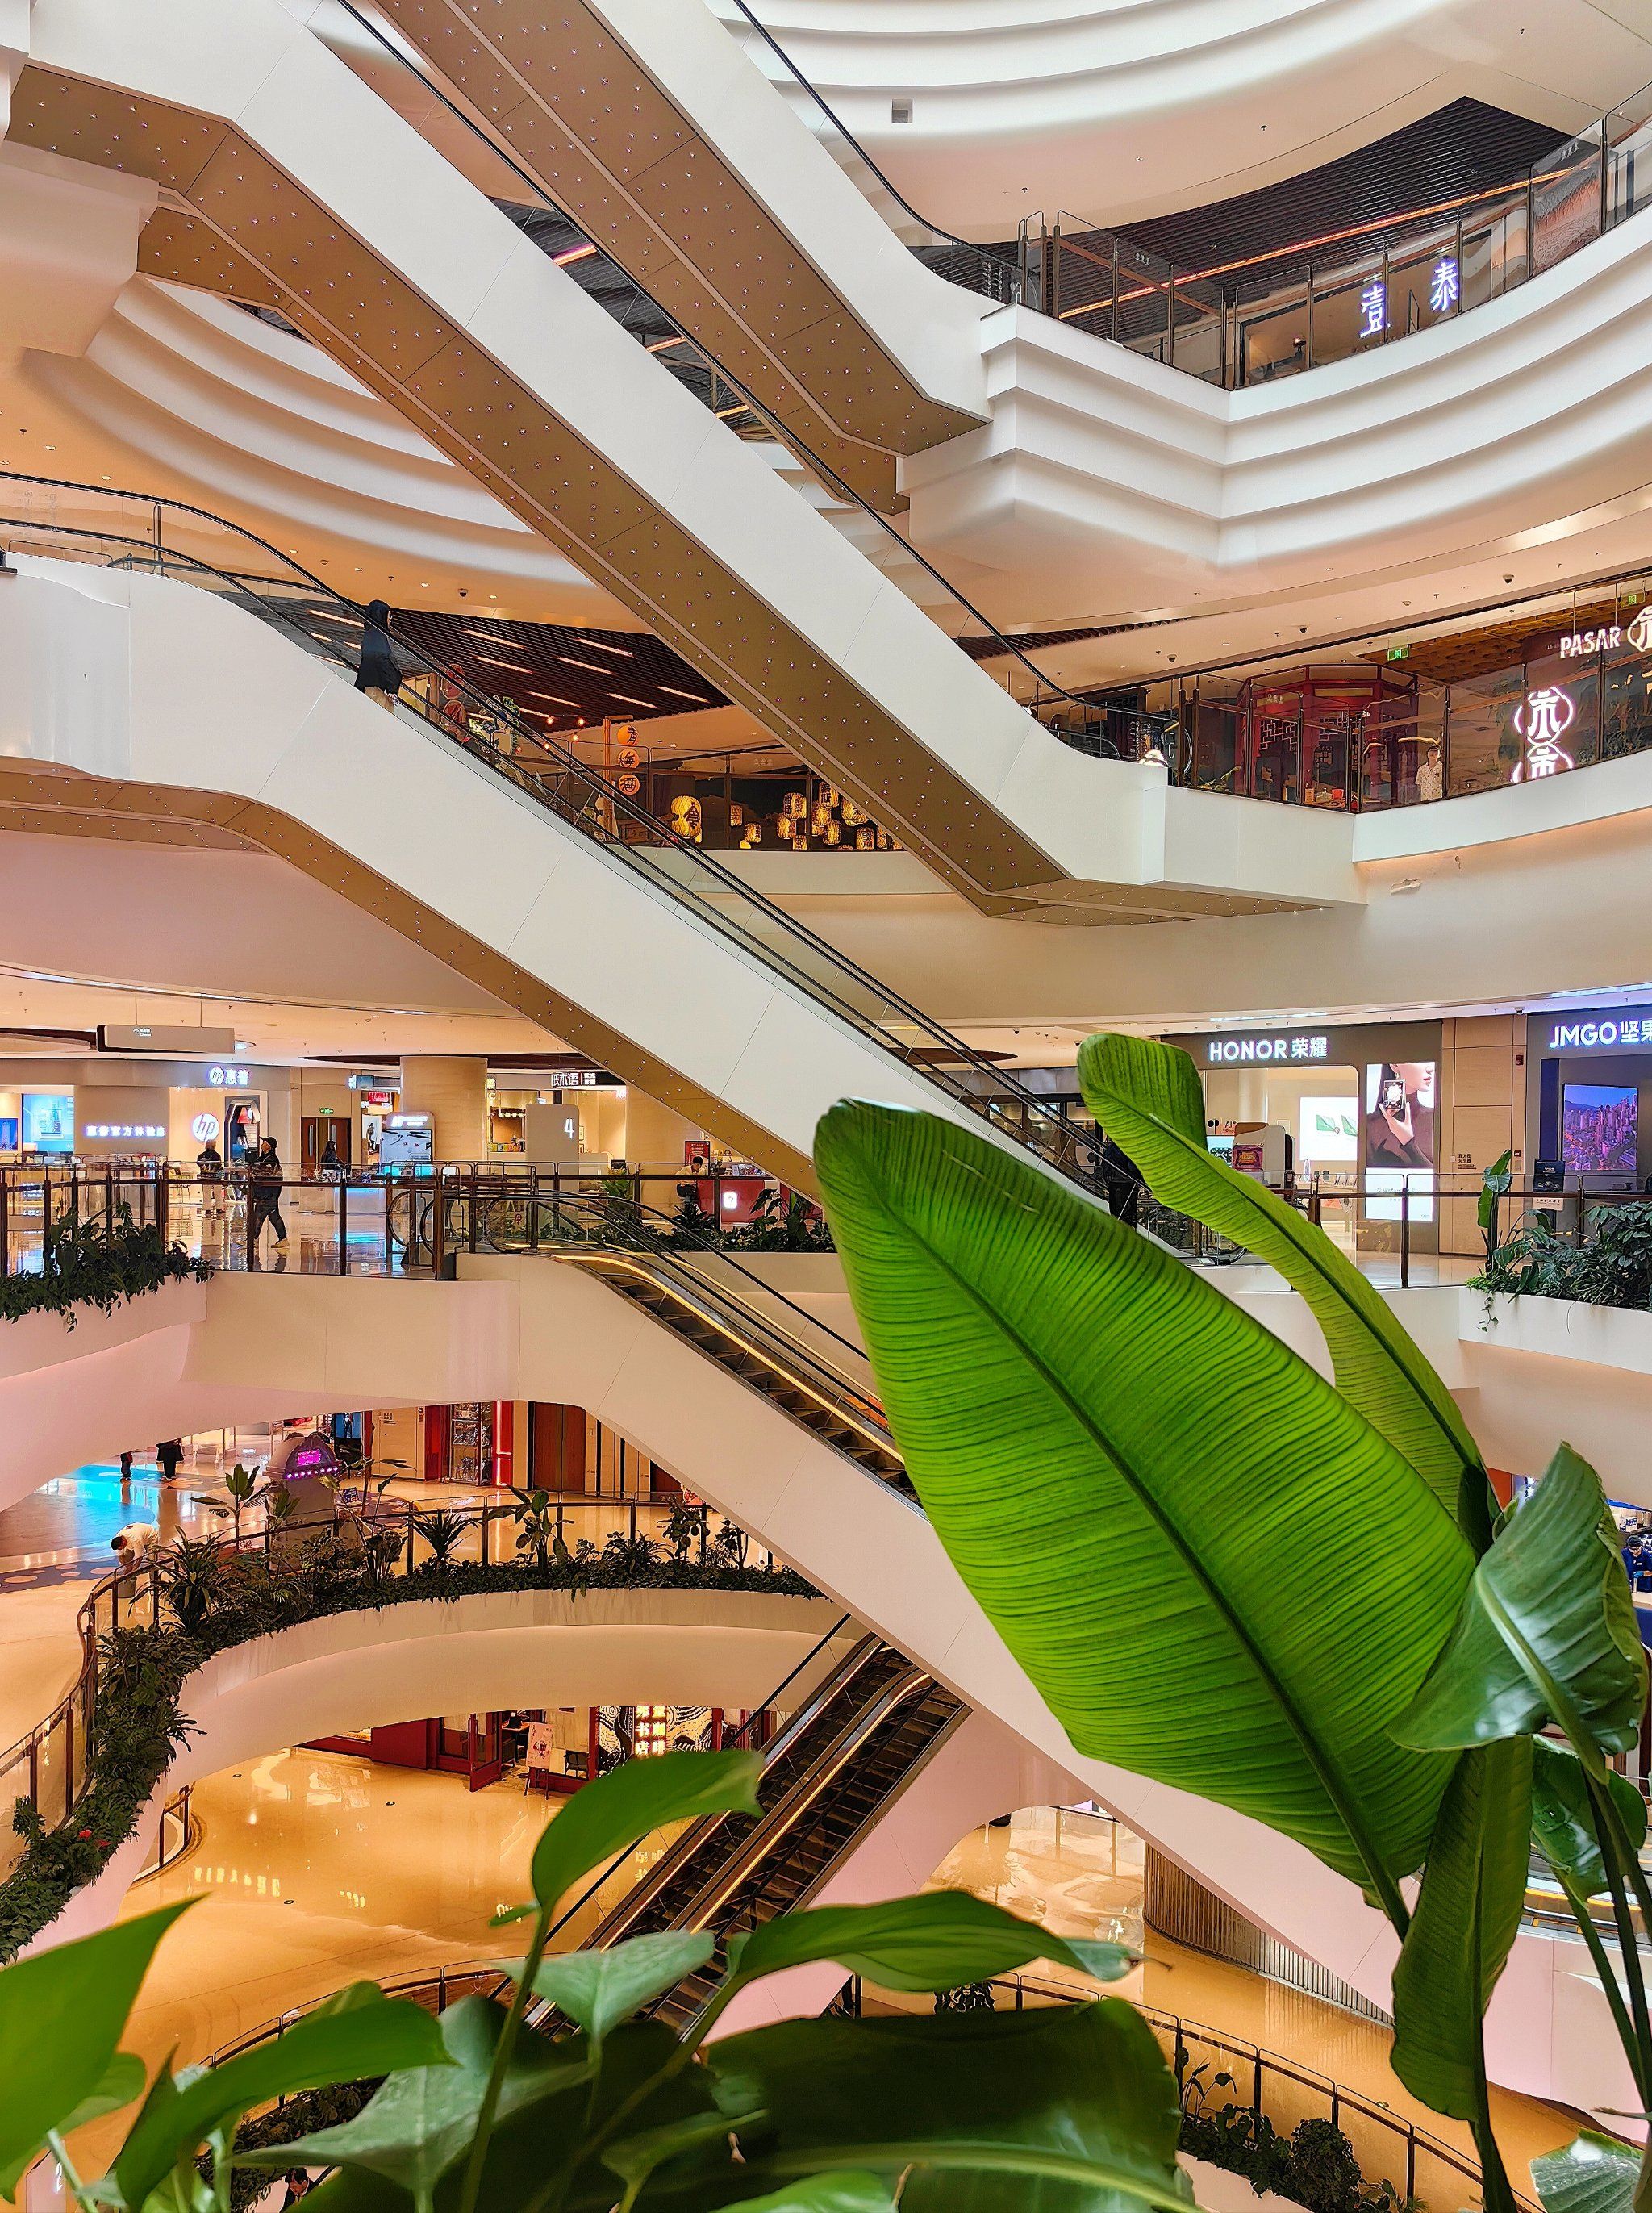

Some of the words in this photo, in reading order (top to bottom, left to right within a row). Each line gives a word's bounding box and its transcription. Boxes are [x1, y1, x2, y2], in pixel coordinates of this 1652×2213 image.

[1359, 285, 1383, 338] 壹
[1429, 262, 1458, 311] 泰
[1559, 626, 1621, 659] PASAR
[1550, 1021, 1617, 1049] JMGO
[1620, 1019, 1652, 1043] 坚果
[1210, 1039, 1288, 1062] HONOR
[1291, 1037, 1328, 1058] 荣耀
[211, 1067, 223, 1084] hp
[194, 1113, 218, 1141] hp
[565, 1118, 574, 1139] 4
